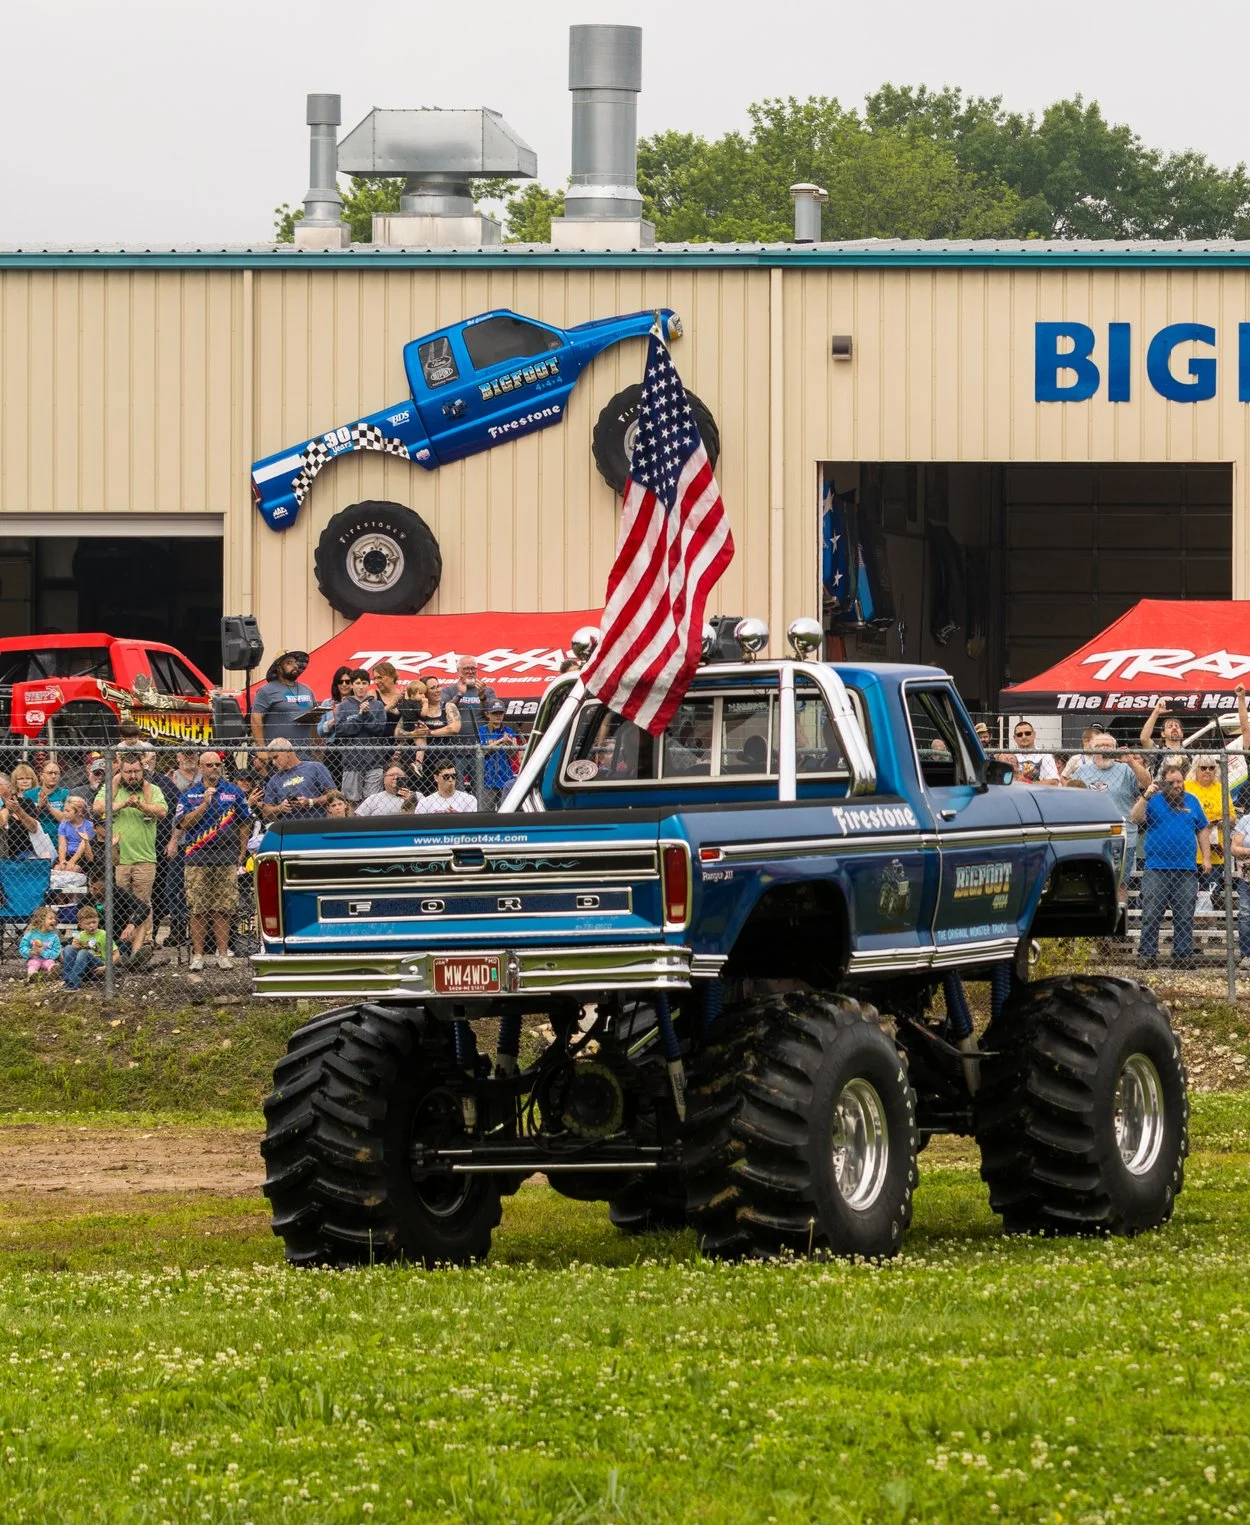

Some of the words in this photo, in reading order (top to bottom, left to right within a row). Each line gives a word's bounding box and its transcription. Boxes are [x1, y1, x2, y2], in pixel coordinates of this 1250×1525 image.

[478, 356, 560, 401] BIGFOOT
[392, 410, 410, 423] BDS
[488, 404, 561, 439] Firestone
[323, 426, 351, 449] 30
[339, 521, 399, 544] Firestone
[349, 648, 586, 674] TRAXXA
[497, 676, 547, 684] Radio
[1056, 693, 1101, 709] The
[832, 806, 916, 836] Firestone
[413, 834, 528, 845] www.bigfoot4x4.com
[702, 871, 724, 883] Ranger
[953, 862, 1012, 899] BIGFOOT
[348, 894, 600, 915] FORD
[937, 930, 947, 941] THE
[947, 928, 969, 940] ORIGINAL
[970, 925, 990, 938] MONSTER
[992, 923, 1008, 935] TRUCK
[444, 964, 490, 986] MW4WD
